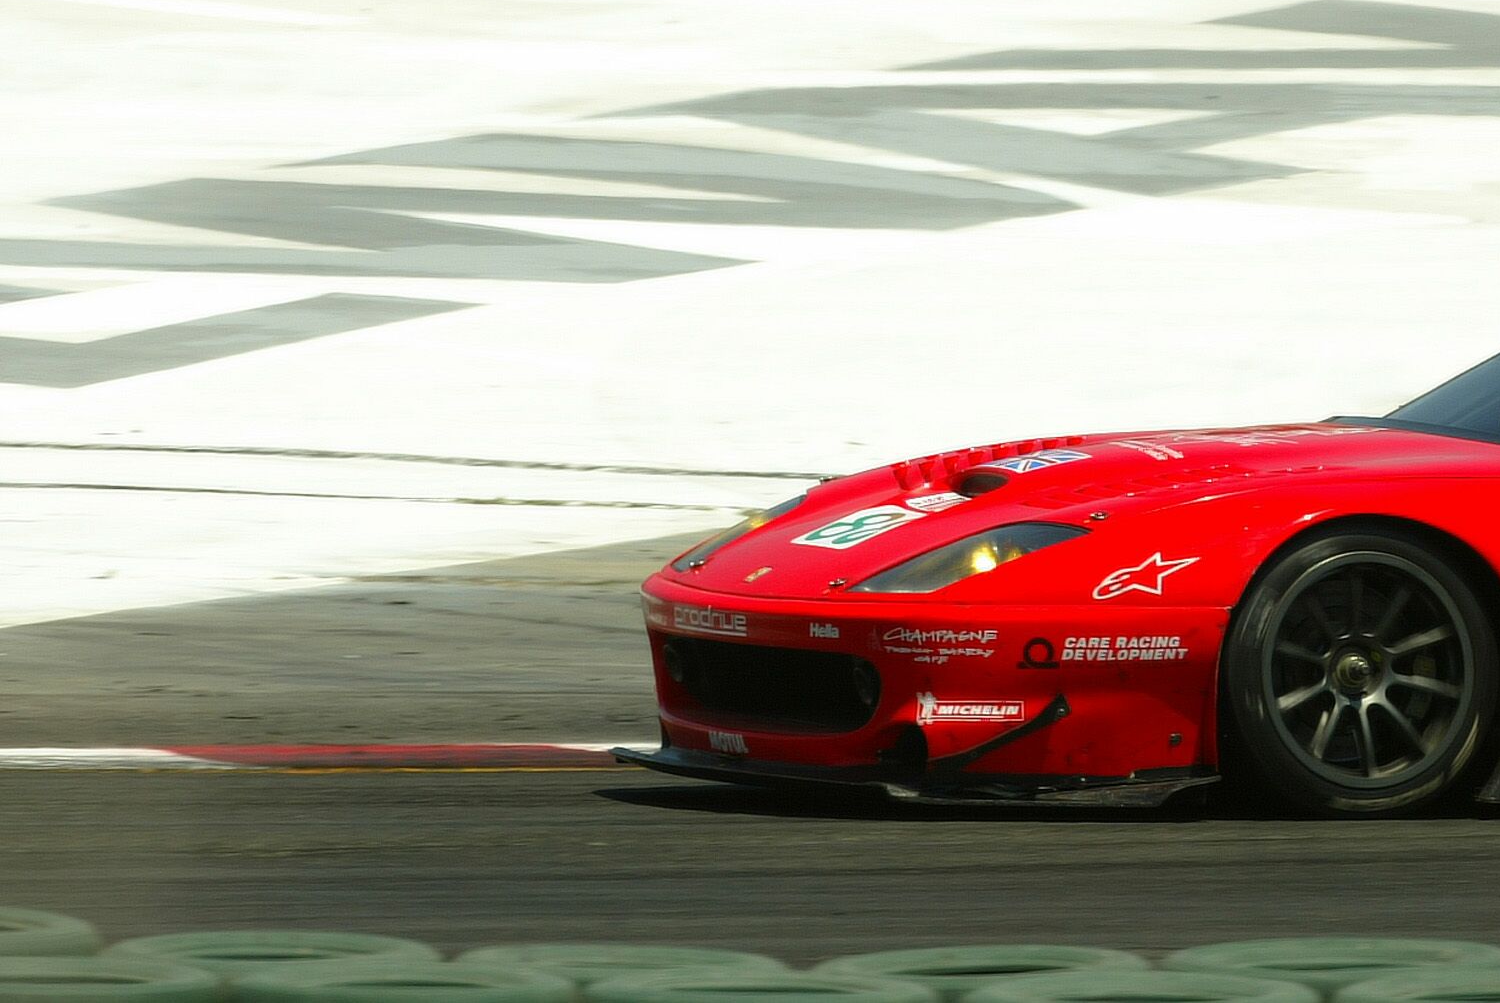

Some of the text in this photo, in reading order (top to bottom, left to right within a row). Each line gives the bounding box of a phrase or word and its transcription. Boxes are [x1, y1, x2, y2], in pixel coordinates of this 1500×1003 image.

[809, 622, 840, 638] Hella
[1064, 635, 1181, 648] CARE RACING
[1060, 648, 1188, 661] DEVELOPMENT
[937, 704, 1020, 716] MICHELIN
